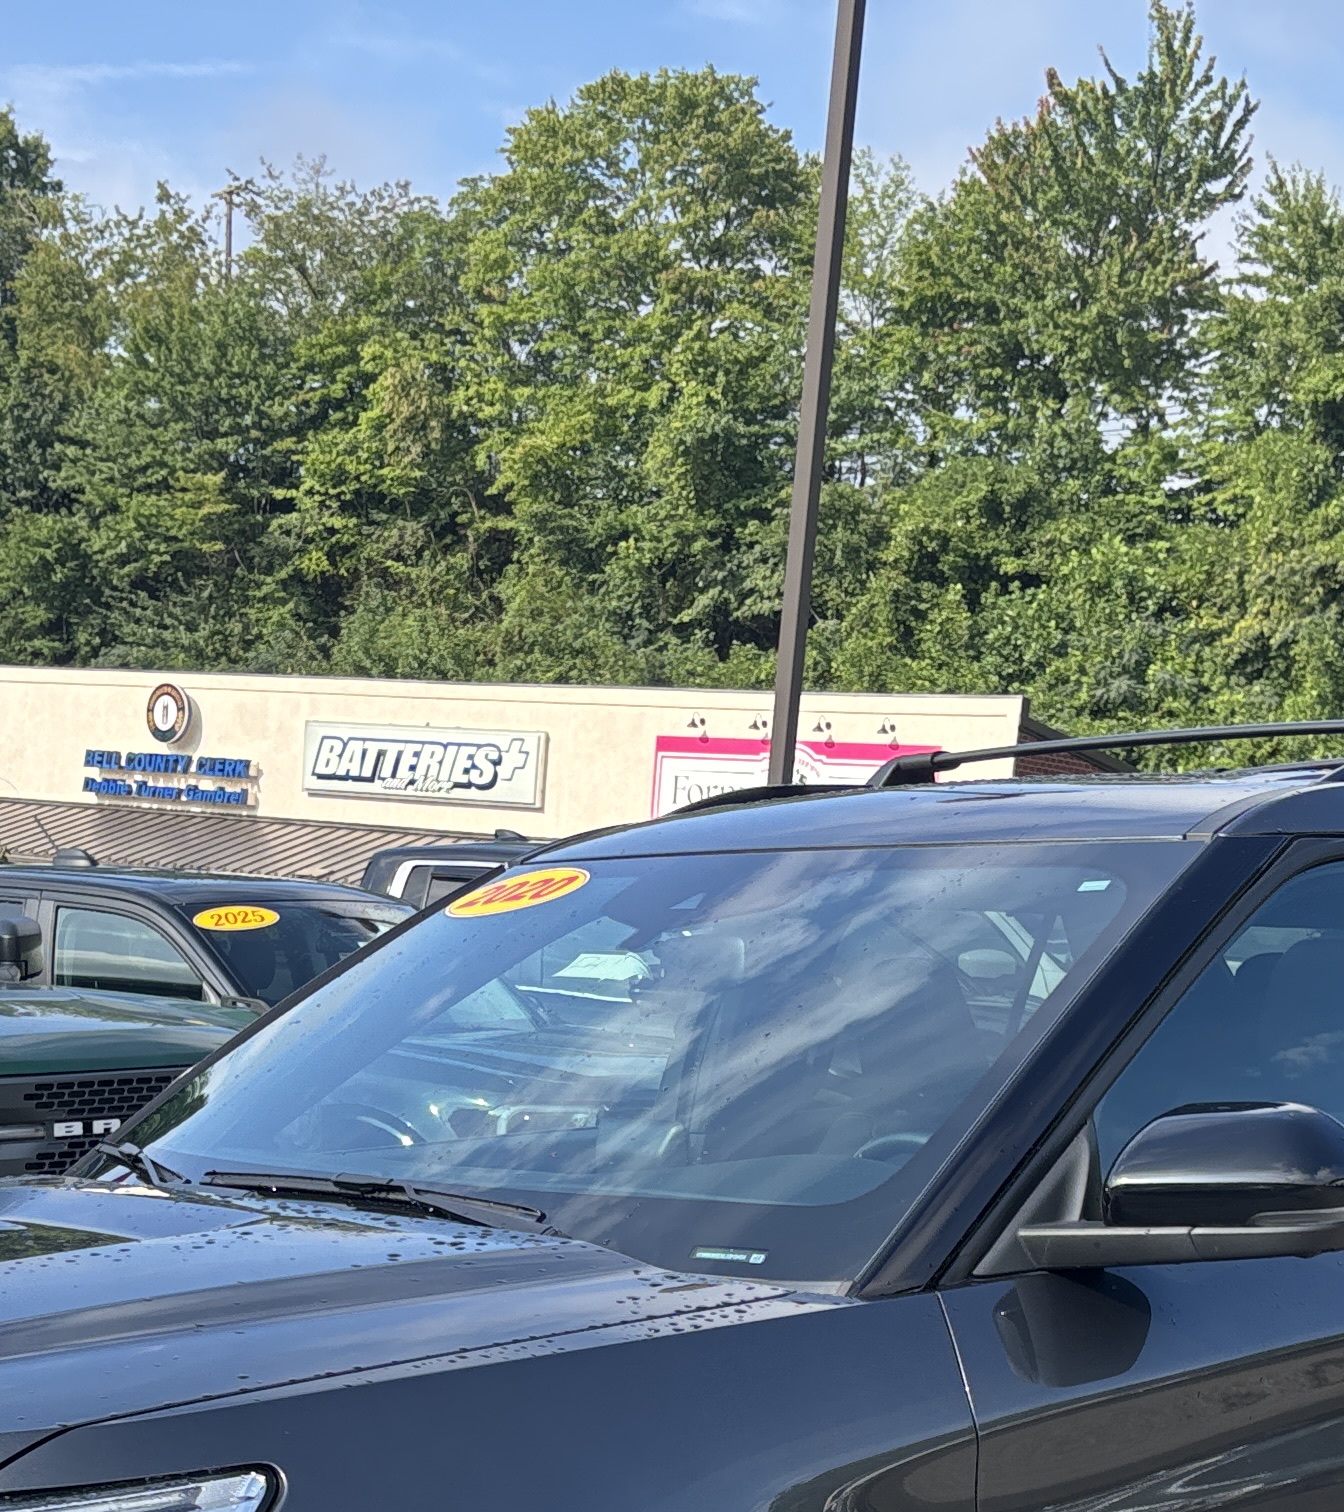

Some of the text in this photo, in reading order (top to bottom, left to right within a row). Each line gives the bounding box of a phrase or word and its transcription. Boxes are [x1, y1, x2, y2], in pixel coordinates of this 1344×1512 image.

[84, 749, 252, 779] BELL COUNTY CLERK
[83, 777, 249, 805] Debbie Turner Gambrel
[381, 772, 455, 794] and More
[461, 875, 579, 909] 2020
[210, 909, 265, 927] 2025
